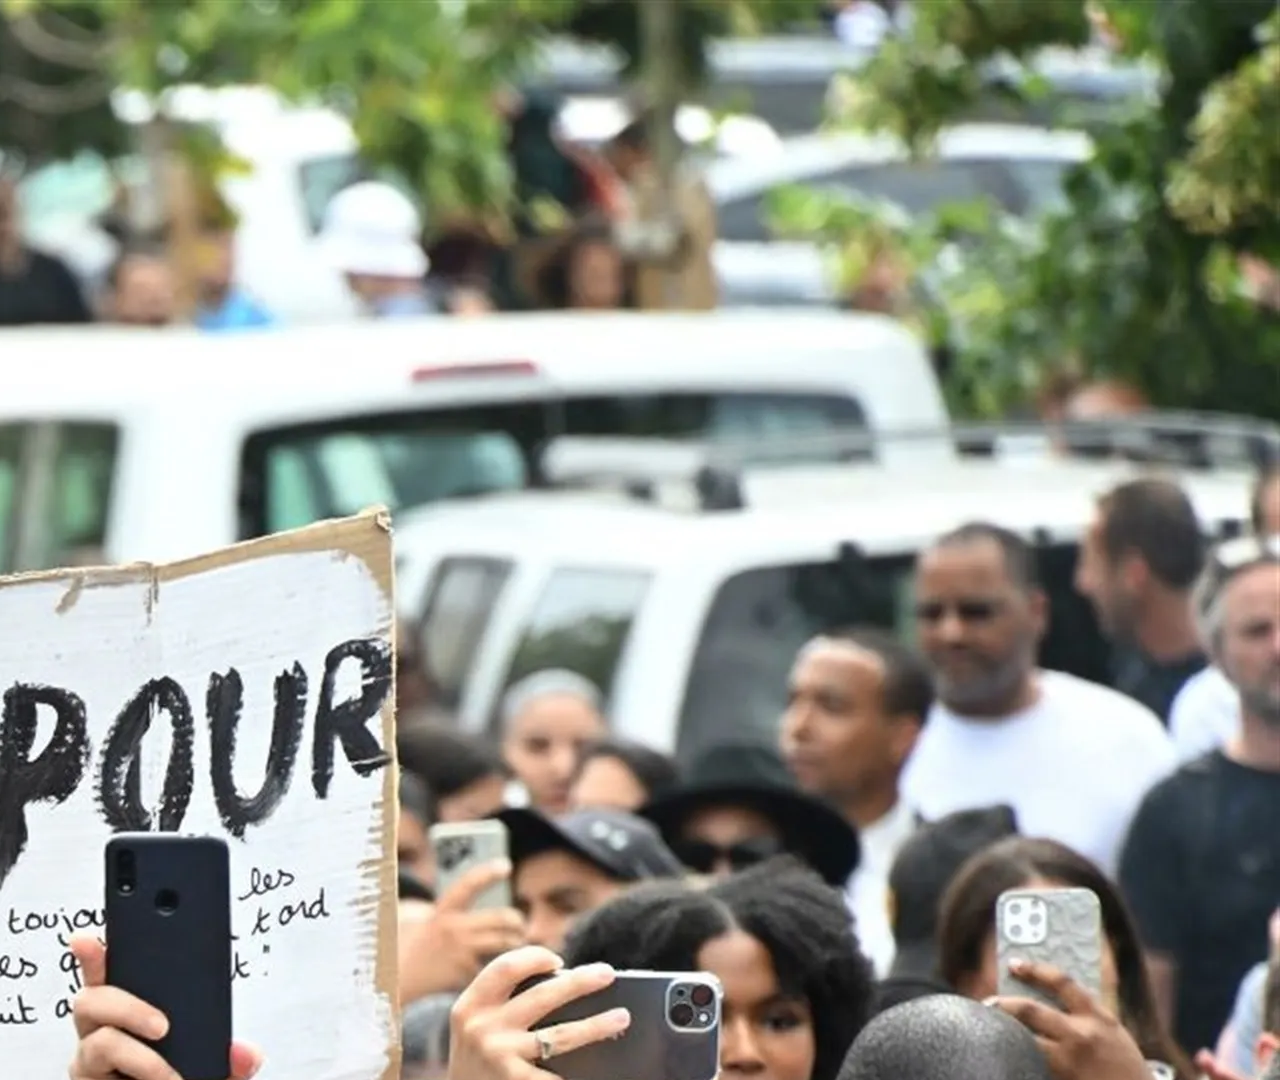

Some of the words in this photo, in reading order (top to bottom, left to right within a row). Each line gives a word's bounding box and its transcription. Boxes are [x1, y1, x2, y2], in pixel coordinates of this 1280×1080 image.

[8, 908, 106, 947] toujou
[237, 867, 295, 901] les
[251, 887, 330, 936] tord
